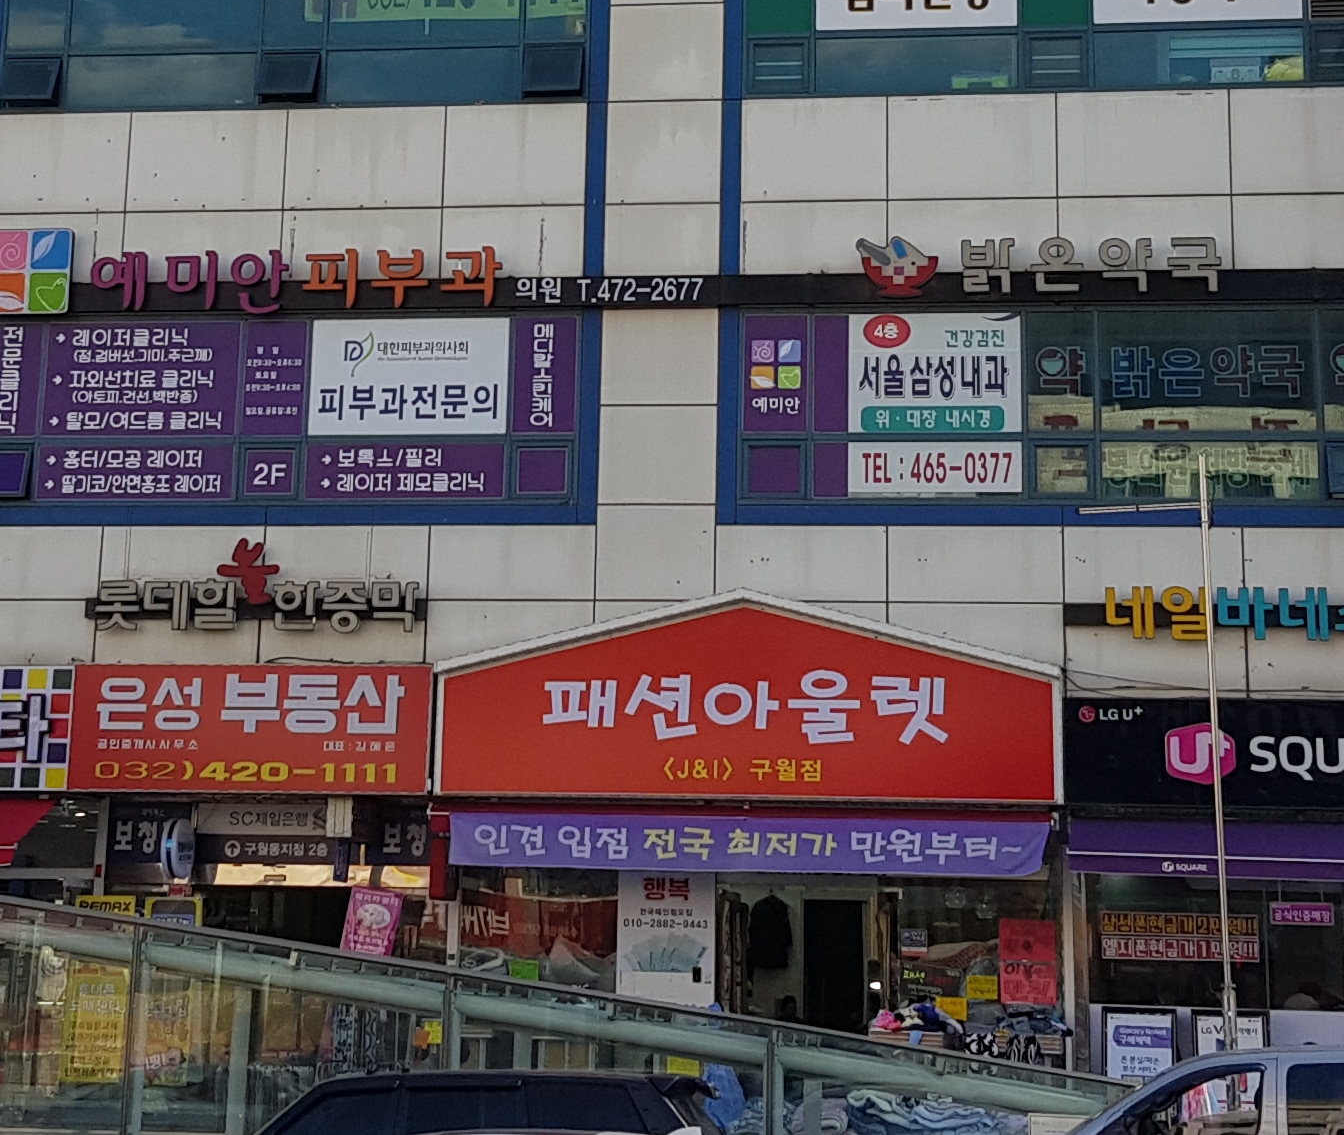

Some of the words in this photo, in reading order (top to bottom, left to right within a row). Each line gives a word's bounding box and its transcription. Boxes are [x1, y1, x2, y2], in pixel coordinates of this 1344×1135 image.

[959, 234, 1223, 296] 밝은약국
[515, 277, 562, 304] 의원
[71, 327, 190, 349] 레이저클리닉
[871, 322, 900, 341] 4층
[944, 327, 1007, 348] 건강검진
[68, 368, 154, 390] 자외선치료
[157, 368, 215, 389] 클리닉
[857, 354, 1011, 398] 서울삼성내과
[1111, 345, 1305, 399] 밝은약국
[317, 382, 500, 422] 피부과전문의
[751, 394, 801, 416] 예미안
[65, 411, 170, 433] 탈모/여드름
[174, 410, 223, 432] 클리닉
[943, 407, 993, 429] 내시경
[61, 448, 142, 470] 흉터/모공
[146, 449, 204, 469] 레이저
[909, 448, 1014, 487] 465-0377
[172, 473, 222, 495] 레이저
[253, 463, 288, 486] 2F
[336, 473, 392, 493] 레이저
[396, 472, 486, 494] 제모클리닉
[91, 578, 238, 632] 롯데힐
[270, 578, 423, 635] 한증막
[96, 676, 203, 732] 은성
[220, 673, 405, 735] 부동산
[541, 668, 950, 746] 패션아울렛
[1098, 708, 1119, 722] LG
[93, 760, 398, 784] 032)420-1111
[749, 758, 824, 783] 구월점
[243, 840, 305, 858] 구월동지점
[472, 824, 547, 858] 인견
[556, 824, 630, 861] 입점
[642, 825, 715, 862] 전국
[727, 827, 839, 859] 최저가
